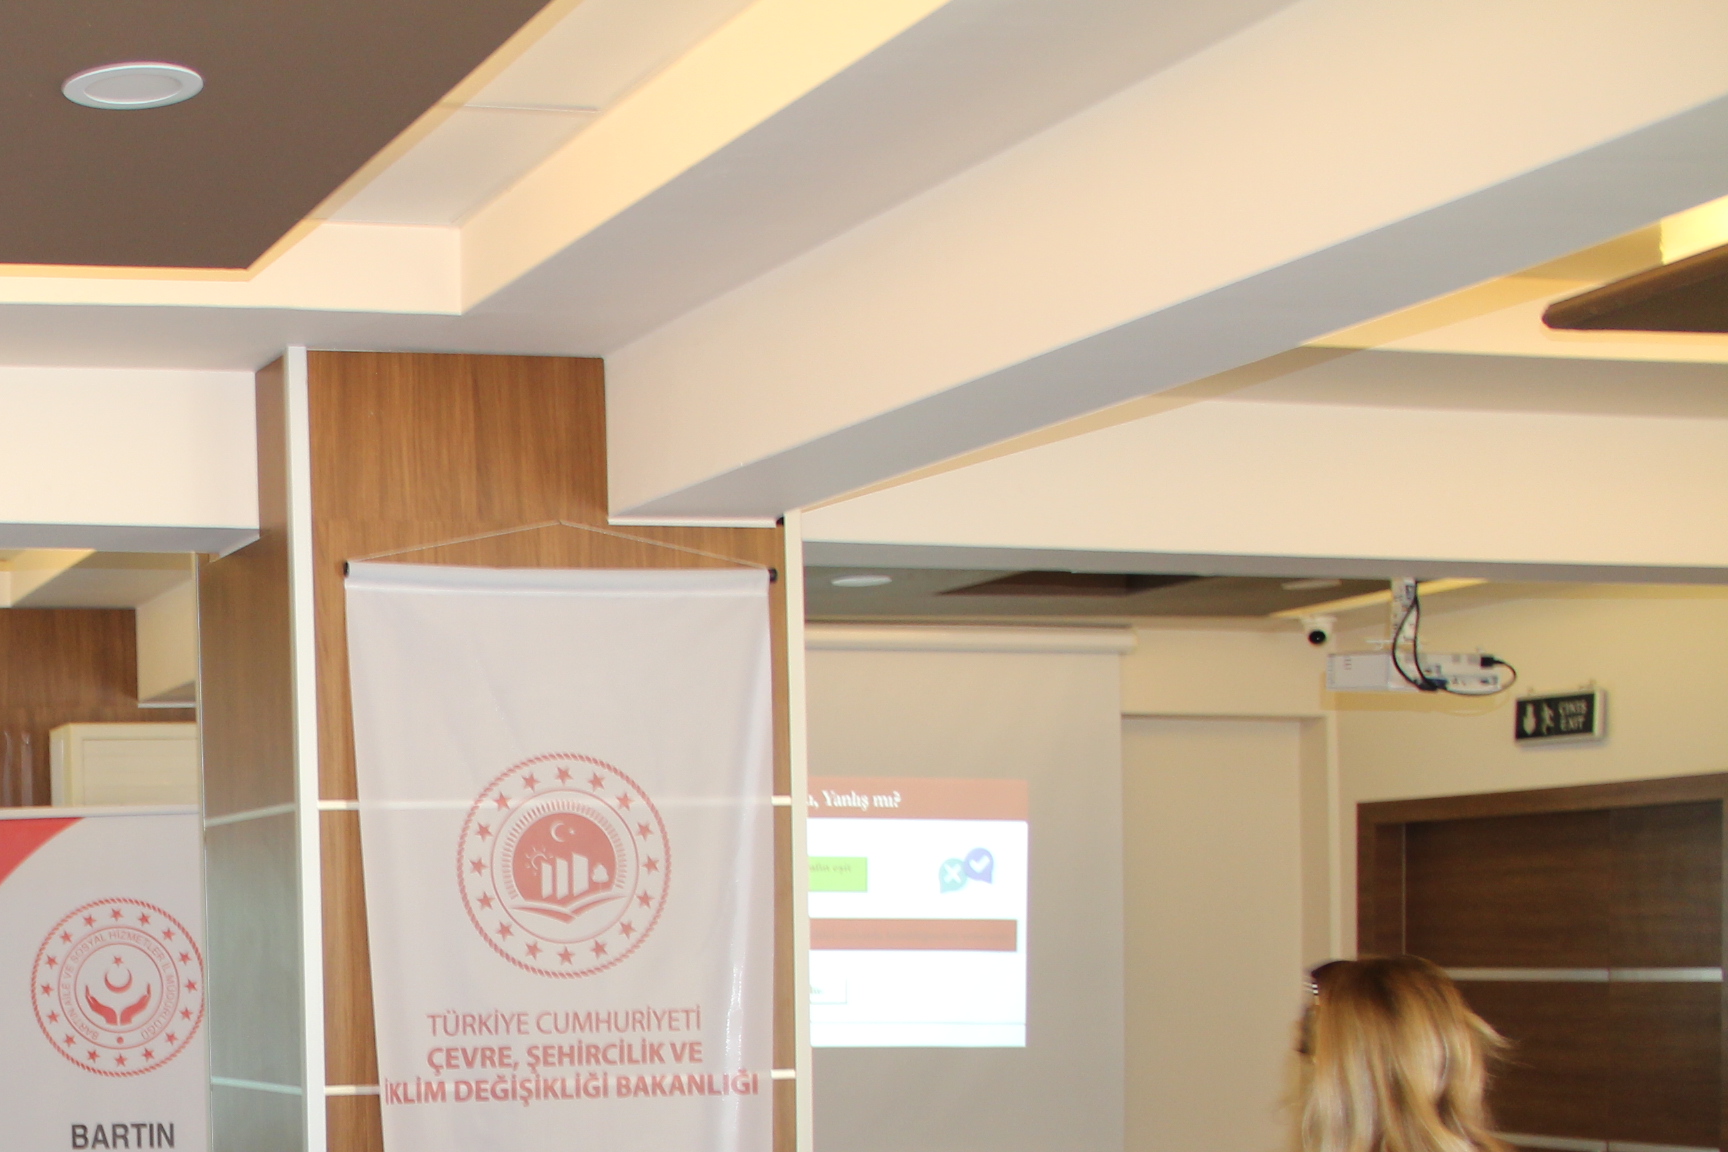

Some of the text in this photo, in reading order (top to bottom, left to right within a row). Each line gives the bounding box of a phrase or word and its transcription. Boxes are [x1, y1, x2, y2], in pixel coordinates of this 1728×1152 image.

[427, 1005, 701, 1036] TÜRKİYE CUMHURİYETİ
[427, 1037, 703, 1076] ÇEVRE, ŞEHİRCİLİK VE
[385, 1068, 759, 1108] İKLİM DEĞİŞİKLİĞİ BAKANLIĞI
[71, 1122, 175, 1149] BARTIN
